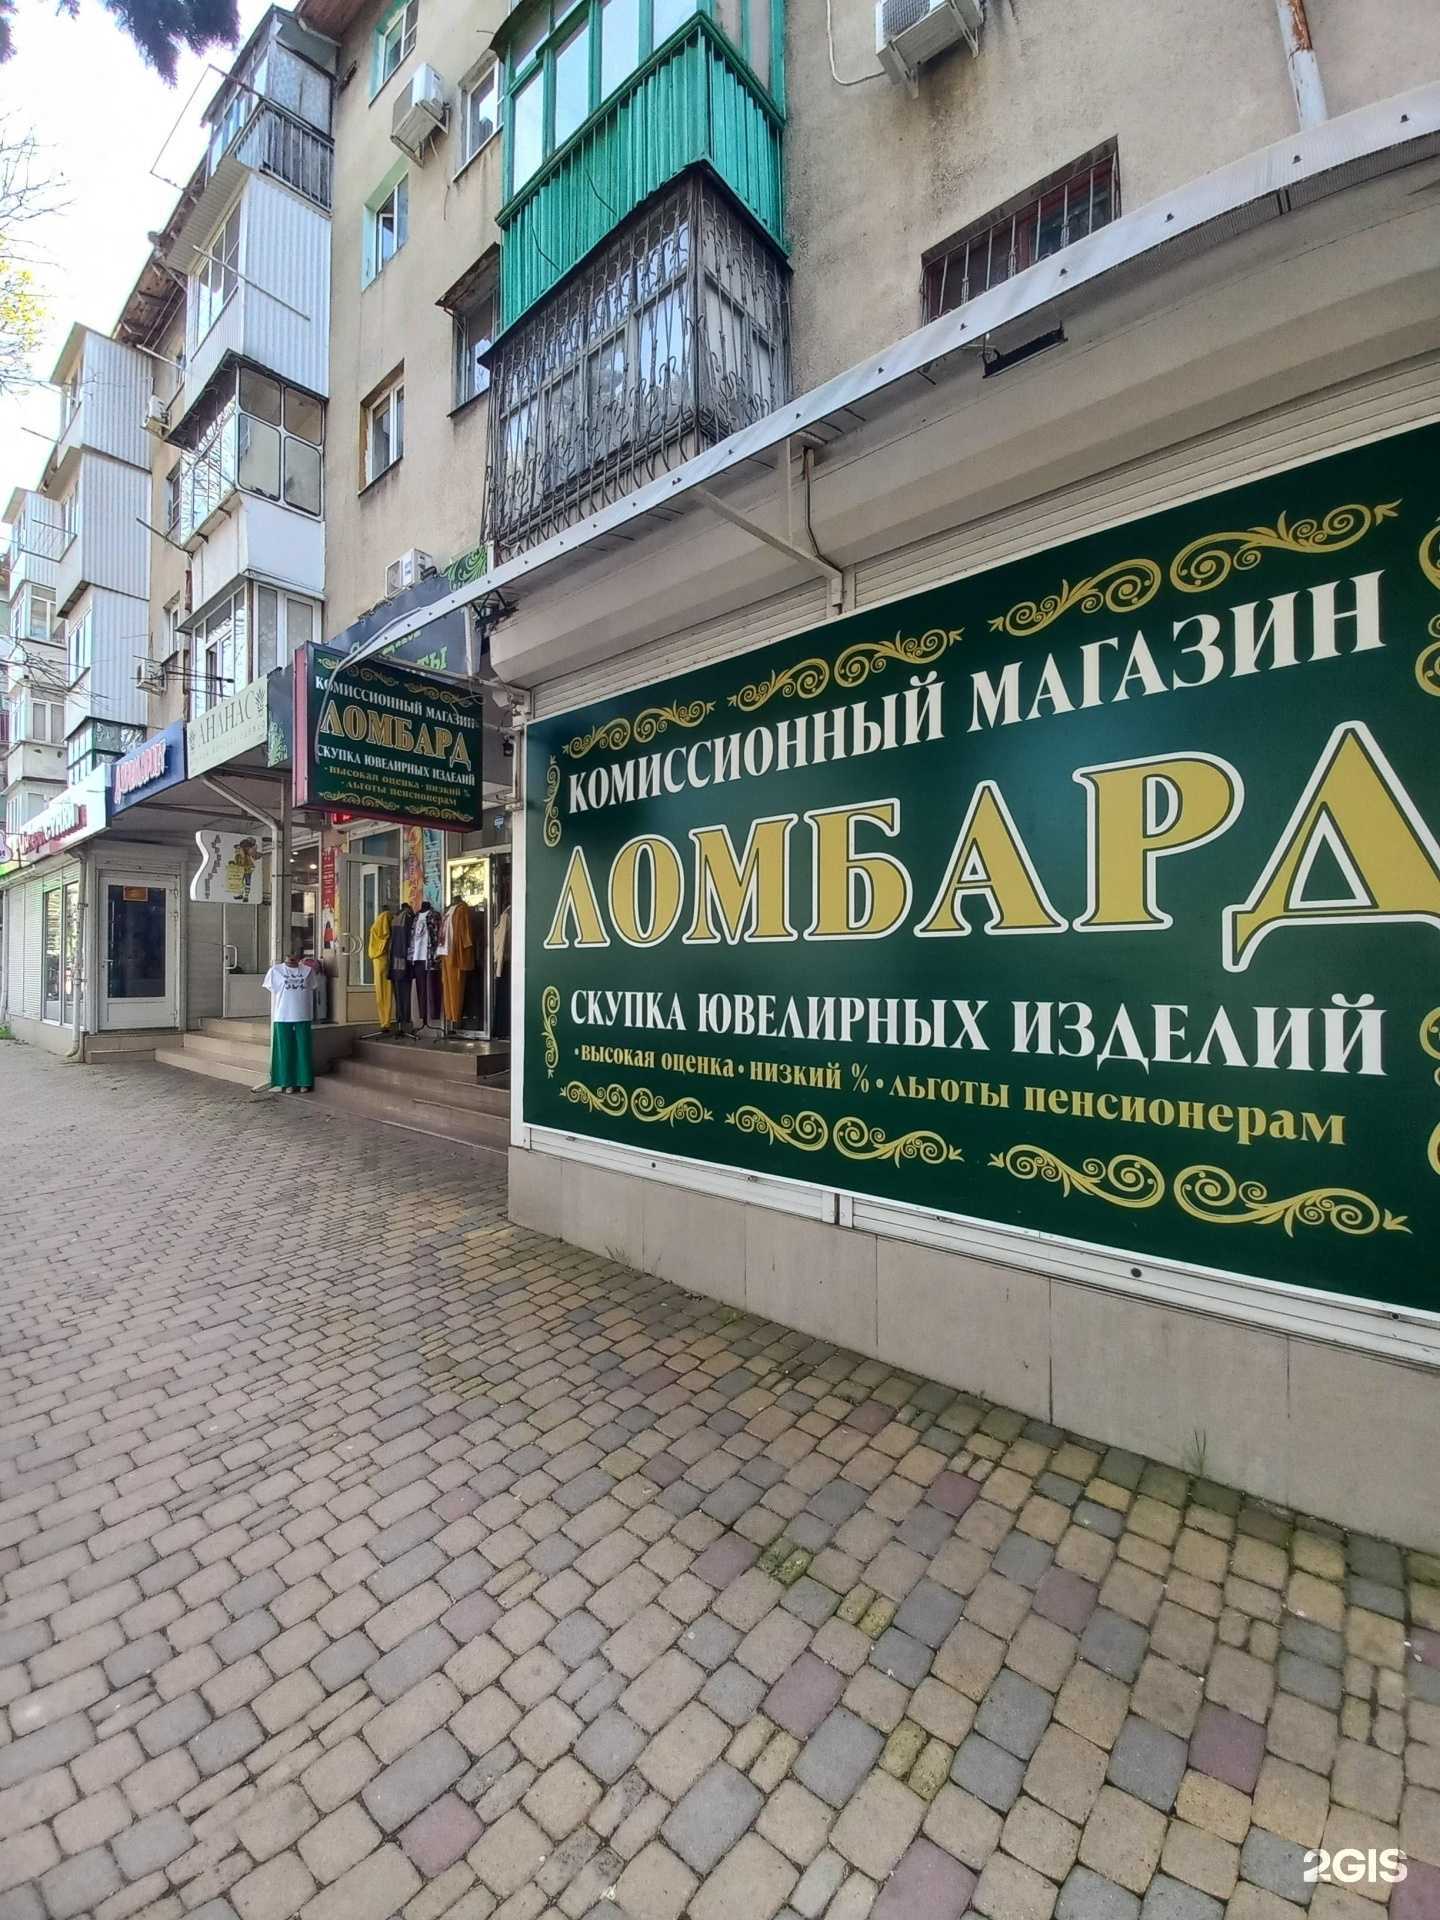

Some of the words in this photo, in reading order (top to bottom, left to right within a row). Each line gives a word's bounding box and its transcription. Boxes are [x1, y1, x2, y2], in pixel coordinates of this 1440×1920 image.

[315, 676, 423, 716] КОМИССИОННЫЙ
[425, 706, 480, 729] МАГАЗИН
[568, 670, 945, 814] КОМИССИОННЫЙ
[966, 569, 1387, 733] МАГАЗИН
[317, 745, 362, 765] СКУПКА
[364, 755, 430, 778] ЮВЕЛИРНЫХ
[432, 767, 476, 787] ИЗДЕЛИЙ
[319, 699, 472, 772] ЛОМБАРД
[329, 766, 379, 781] высокая
[382, 775, 420, 789] оценка
[346, 781, 387, 793] льготы
[389, 787, 457, 806] пенсионерам
[543, 720, 1440, 974] ЛОМБАРД
[570, 989, 688, 1031] СКУПКА
[698, 992, 991, 1051] ЮВЕЛИРНЫХ
[1011, 992, 1390, 1076] ИЗДЕЛИЙ
[580, 1043, 656, 1069] высокая
[660, 1053, 735, 1078] оценка
[749, 1061, 842, 1090] низкий
[888, 1076, 1010, 1111] льготы
[1023, 1084, 1347, 1146] пенсионерам
